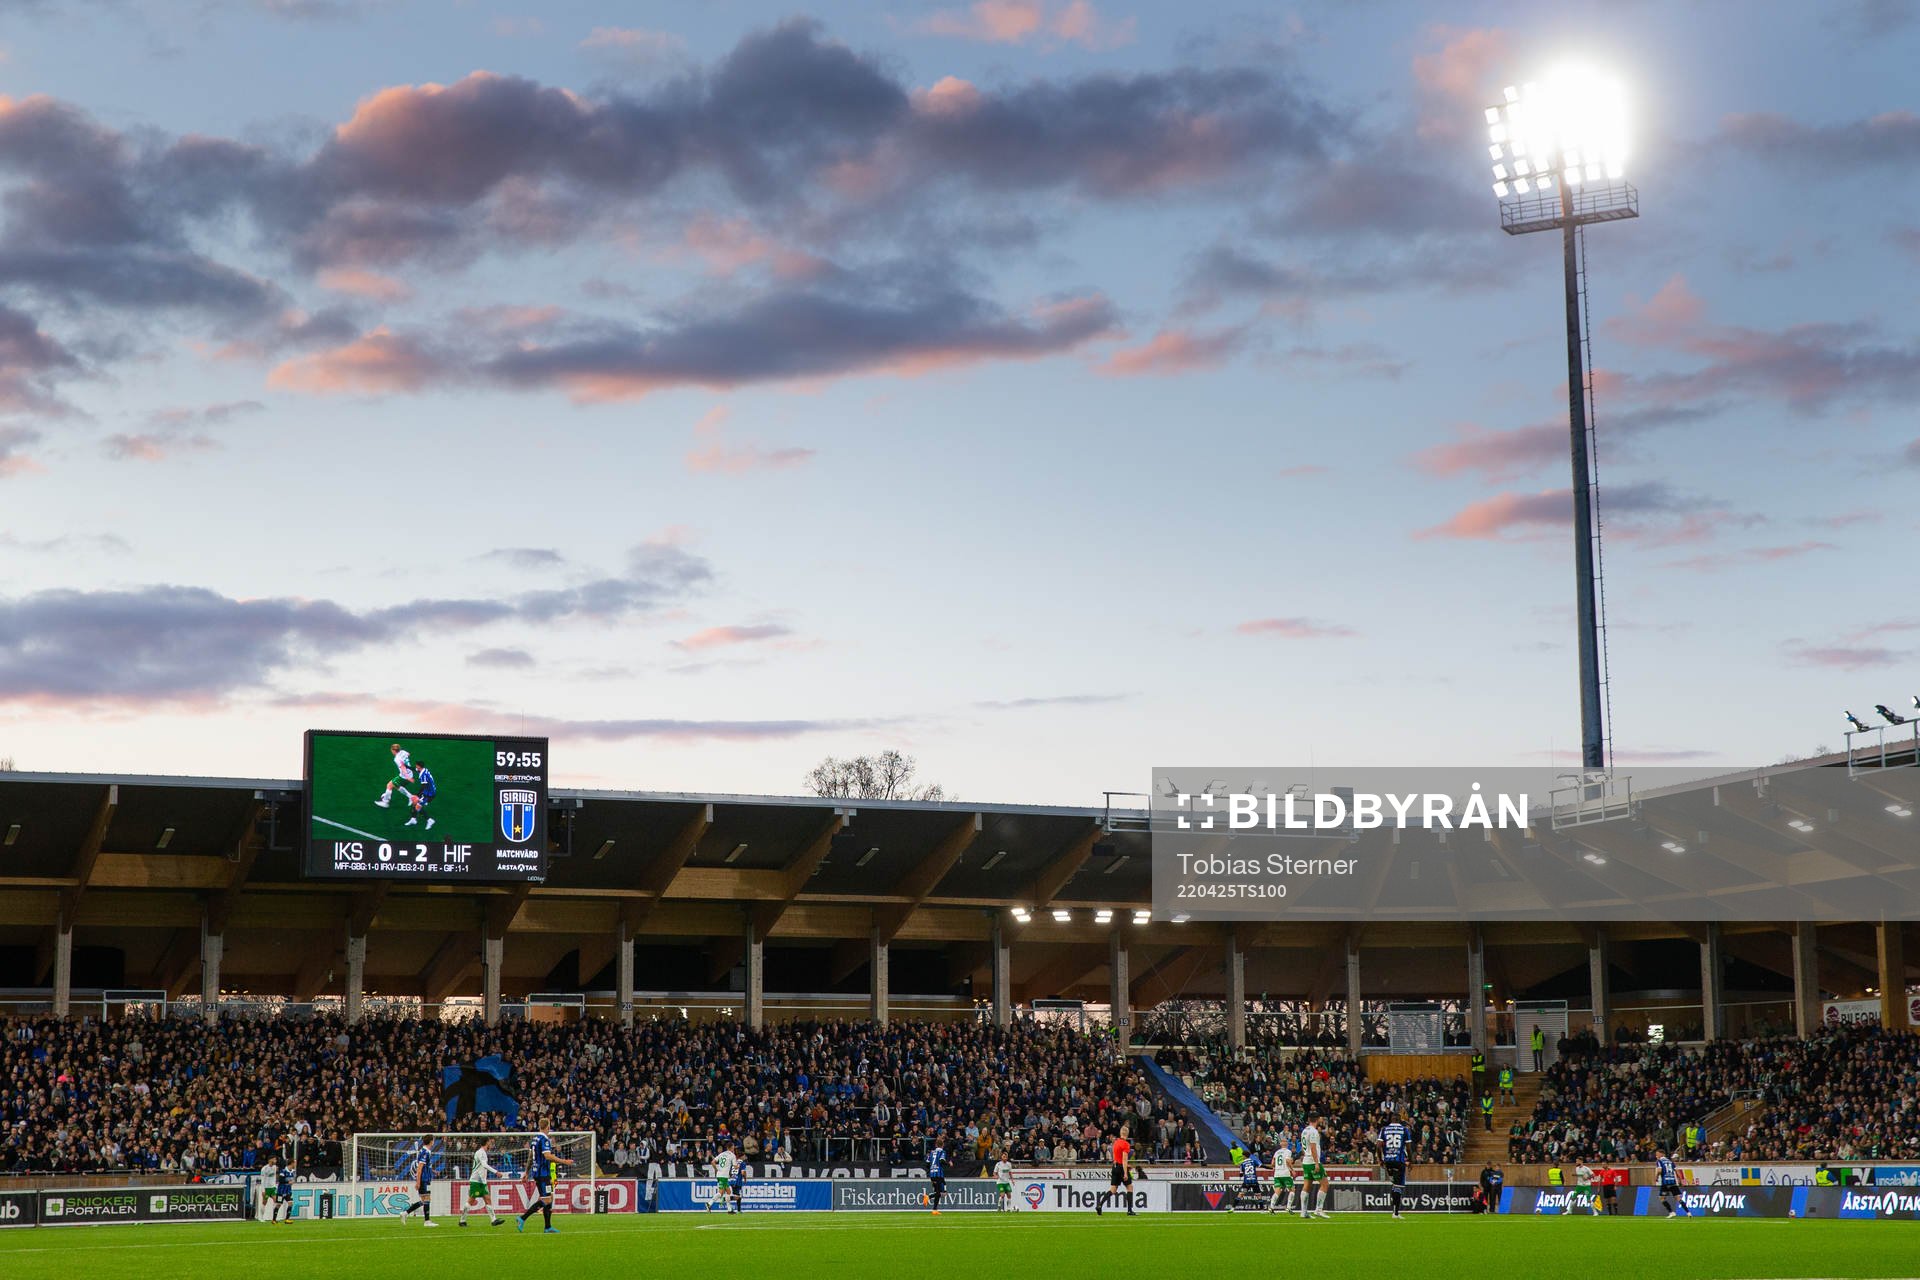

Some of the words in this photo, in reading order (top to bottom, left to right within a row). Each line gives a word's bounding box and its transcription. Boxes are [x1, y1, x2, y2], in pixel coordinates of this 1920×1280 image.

[496, 751, 542, 768] 59:55
[502, 791, 534, 803] SIRIUS
[334, 842, 364, 861] IKS
[378, 843, 392, 862] 0
[415, 844, 428, 862] 2
[443, 844, 472, 863] HIF
[496, 848, 539, 859] MATCHVÅRD
[525, 864, 538, 872] TAK
[1385, 1134, 1401, 1148] 26
[1276, 1154, 1283, 1165] 6
[1175, 1171, 1199, 1179] 018-36
[1200, 1171, 1210, 1179] 94
[1211, 1171, 1219, 1179] 95
[1244, 1165, 1255, 1175] 23
[1201, 1184, 1227, 1192] TEAM
[65, 1196, 137, 1207] SNICKERI
[170, 1194, 239, 1204] SNICKERI
[1052, 1184, 1148, 1208] Therma
[1365, 1193, 1417, 1208] Railay
[1537, 1191, 1562, 1208] ÅRSTA
[1725, 1194, 1746, 1209] TAK
[1842, 1191, 1882, 1211] ÅRSTA
[65, 1205, 137, 1215] PORTALEN
[169, 1203, 239, 1213] PORTALEN
